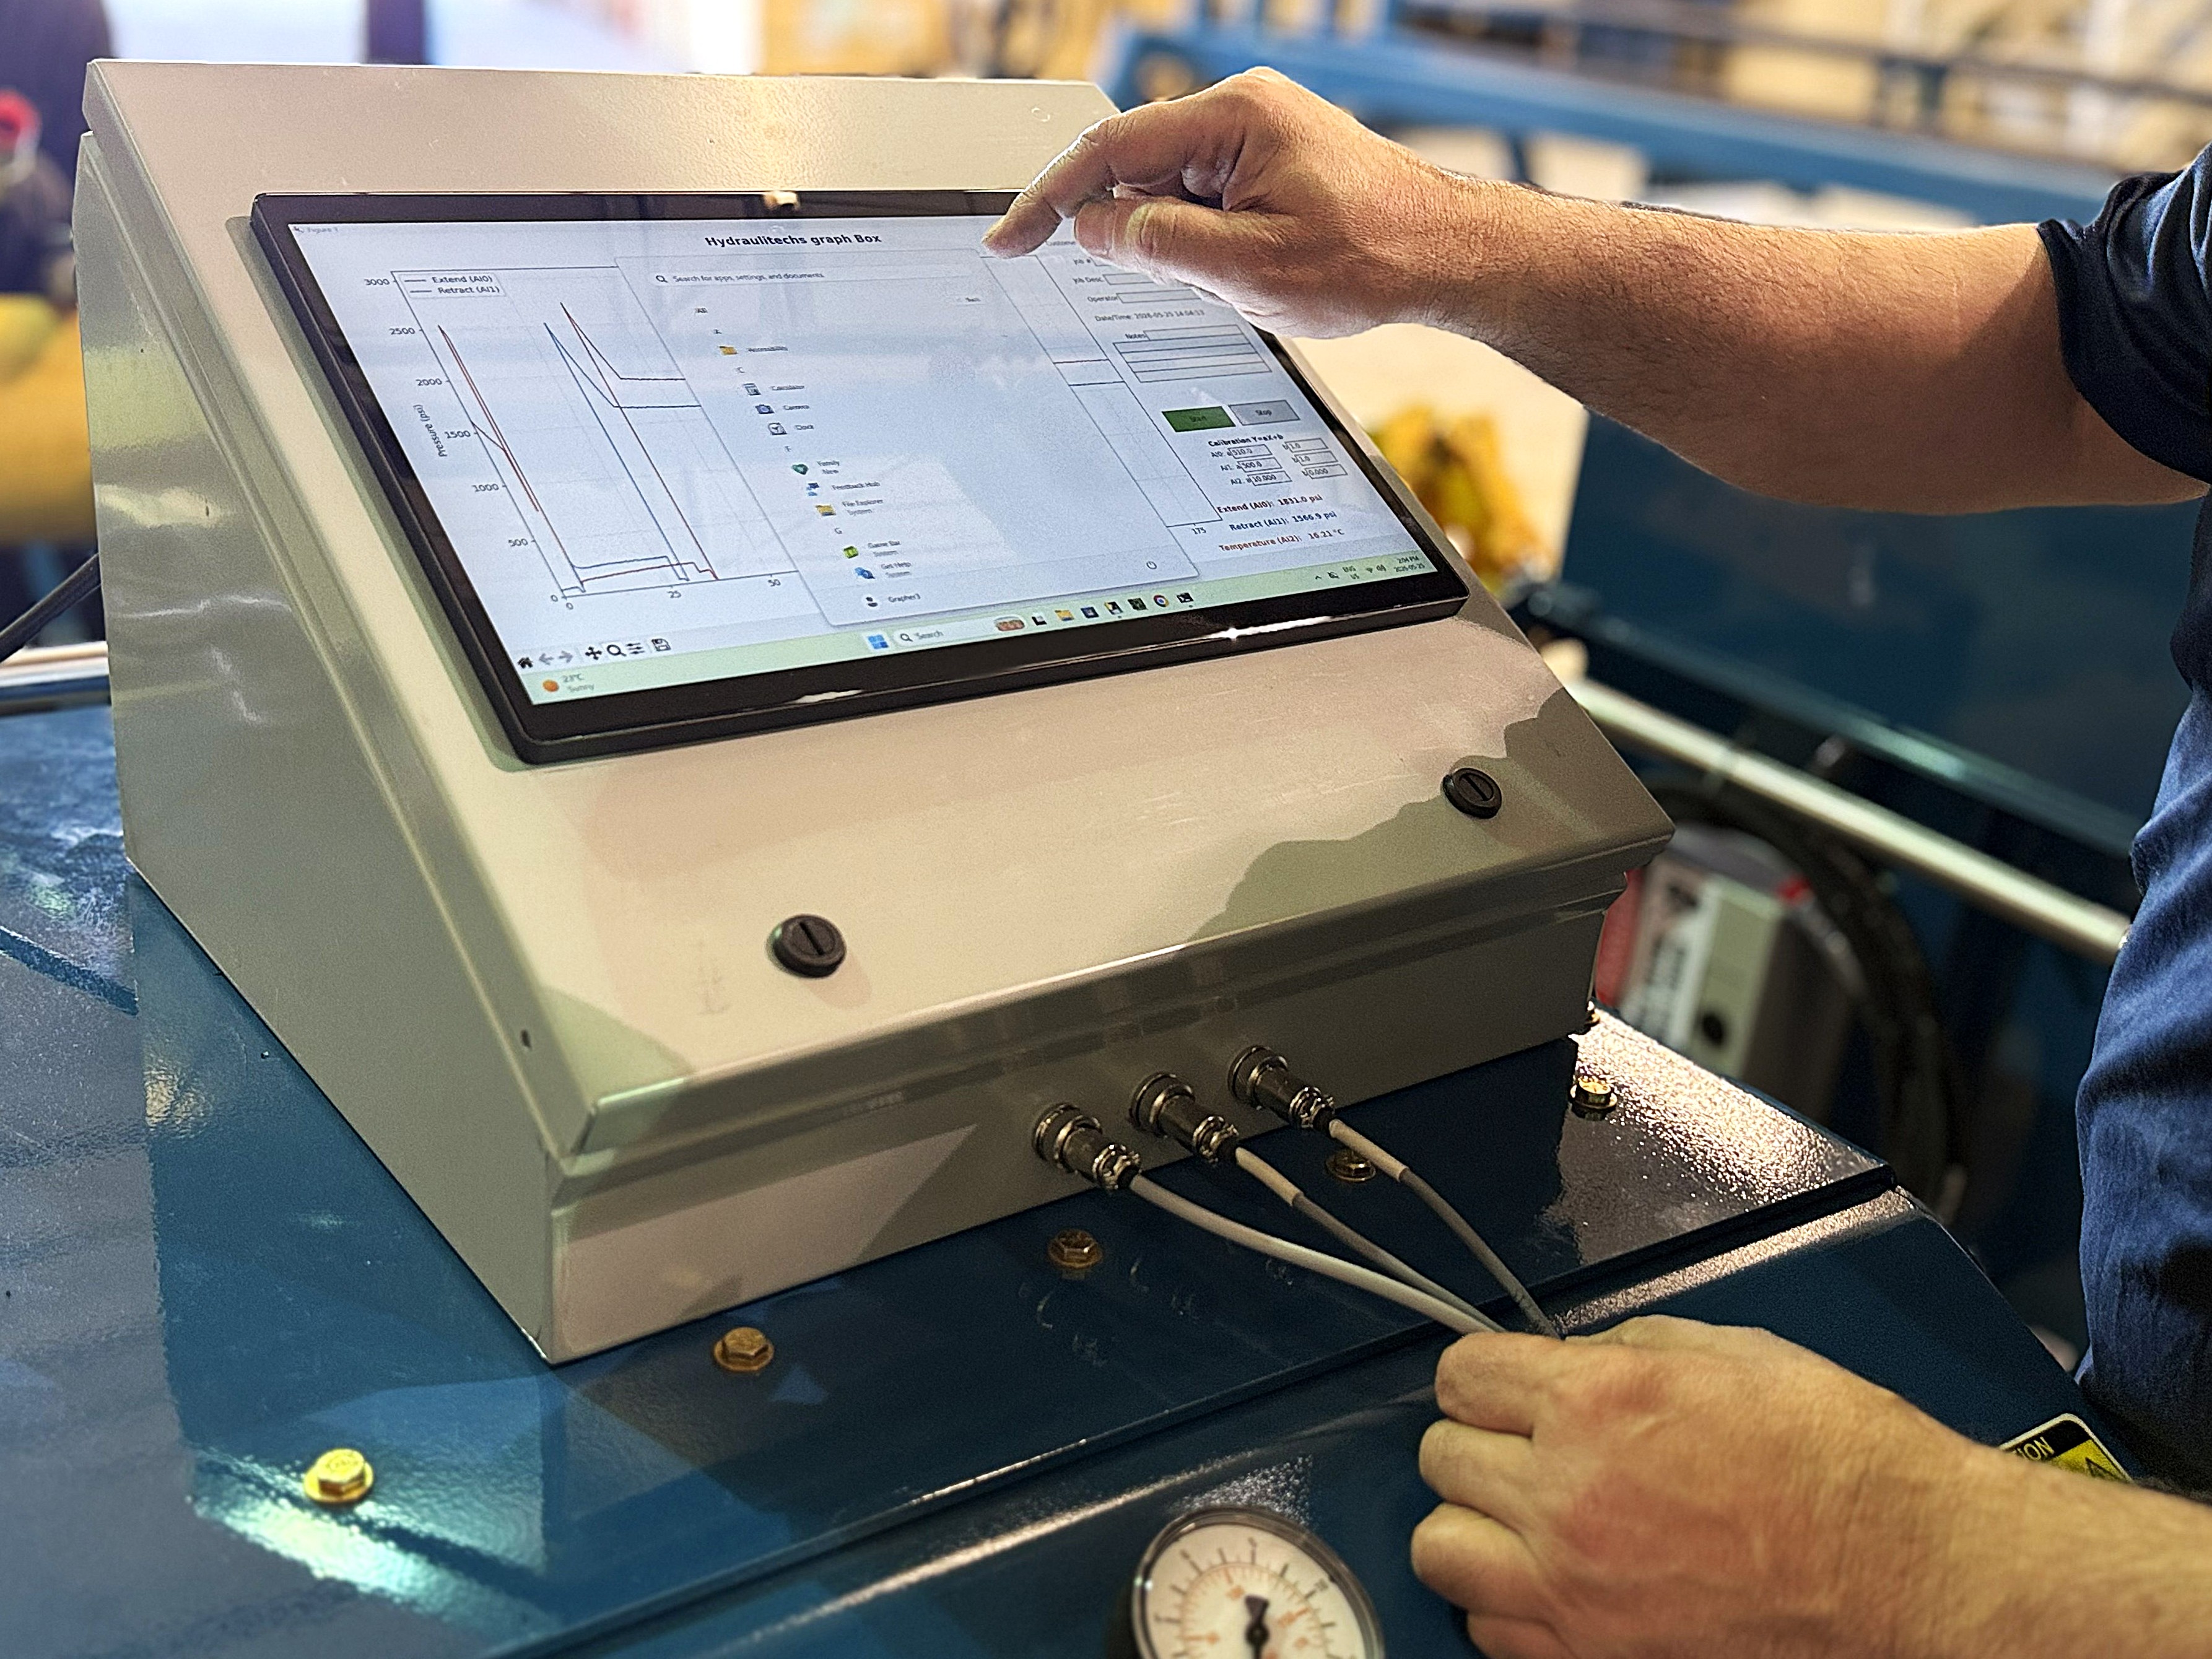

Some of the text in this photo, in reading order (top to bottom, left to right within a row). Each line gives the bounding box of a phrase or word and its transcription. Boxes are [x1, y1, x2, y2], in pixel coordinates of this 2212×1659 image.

[705, 234, 882, 247] Hydraulitechs graph Box
[416, 378, 442, 386] 2000
[413, 404, 448, 457] Pressure (psi)
[445, 430, 471, 438] 1500
[1208, 437, 1252, 446] Calibration
[472, 484, 499, 492] 1000
[1217, 503, 1249, 513] Extend
[1278, 496, 1308, 506] 1831.0
[1309, 494, 1323, 503] psi
[1229, 521, 1263, 531] Retract
[1292, 513, 1322, 523] 1566.9
[1323, 510, 1338, 520] psi
[508, 539, 528, 547] 500
[1219, 538, 1276, 551] Temperature
[1308, 529, 1333, 539] 16.21
[768, 579, 780, 587] 50
[667, 590, 682, 599] 25
[915, 630, 943, 639] Search
